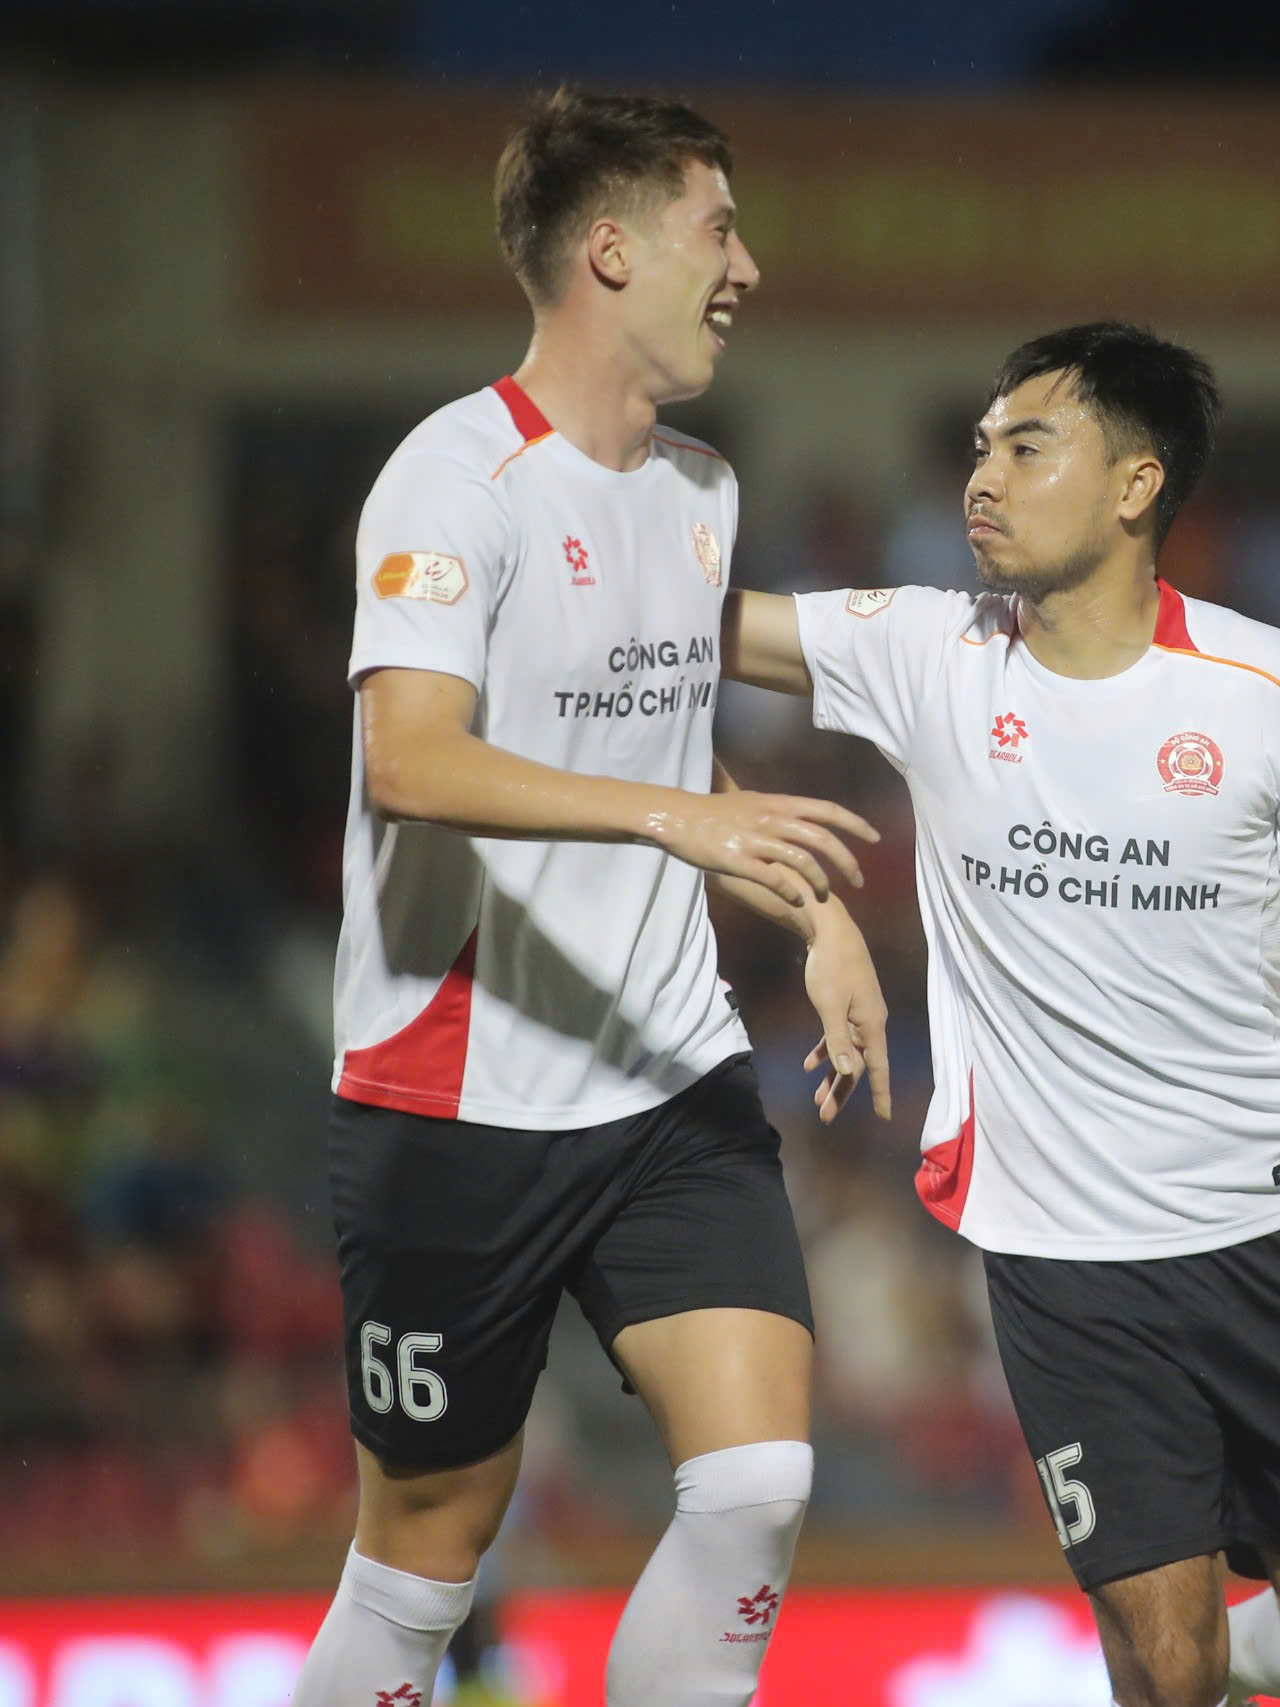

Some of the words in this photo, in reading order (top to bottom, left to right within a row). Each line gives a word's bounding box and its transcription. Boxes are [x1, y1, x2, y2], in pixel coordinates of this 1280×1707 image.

[608, 637, 679, 673] CÔNG
[686, 636, 713, 664] AN
[639, 676, 685, 716] CHÍ
[1008, 820, 1109, 863] CÔNG
[1119, 838, 1170, 867] AN
[961, 853, 1049, 899] TP.HỒ
[1058, 874, 1121, 908] CHÍ
[1131, 883, 1221, 911] MINH
[360, 1320, 448, 1422] 66
